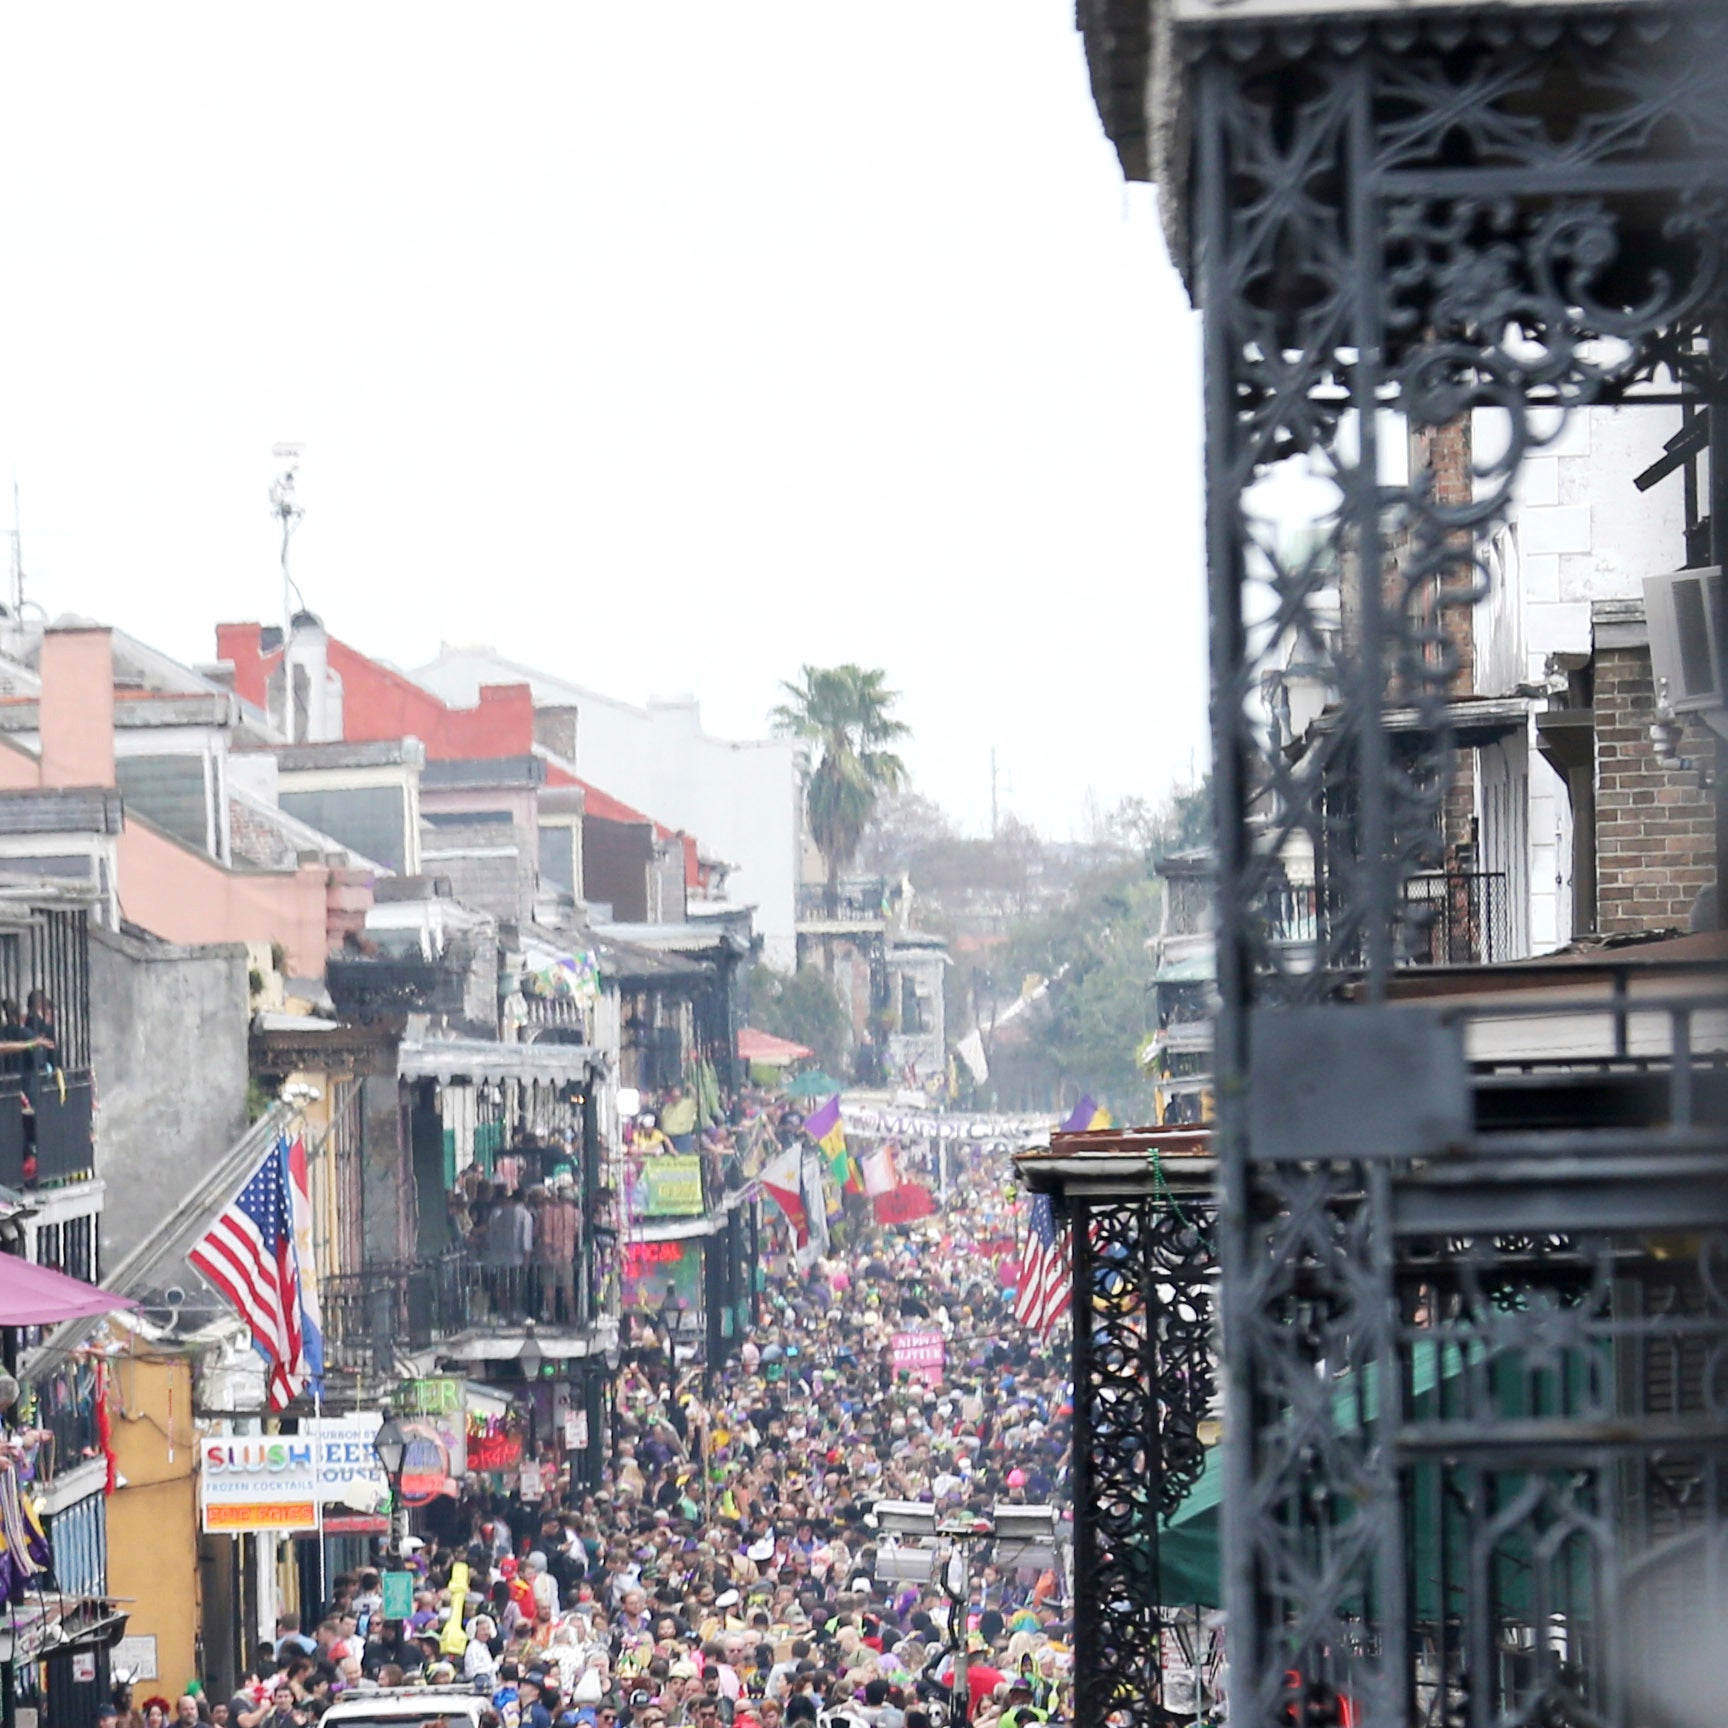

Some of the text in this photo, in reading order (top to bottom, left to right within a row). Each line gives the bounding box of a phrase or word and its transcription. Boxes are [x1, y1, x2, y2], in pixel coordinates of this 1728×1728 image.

[207, 1444, 313, 1474] SLUSH
[206, 1481, 314, 1491] FROZEN COCKTAILS
